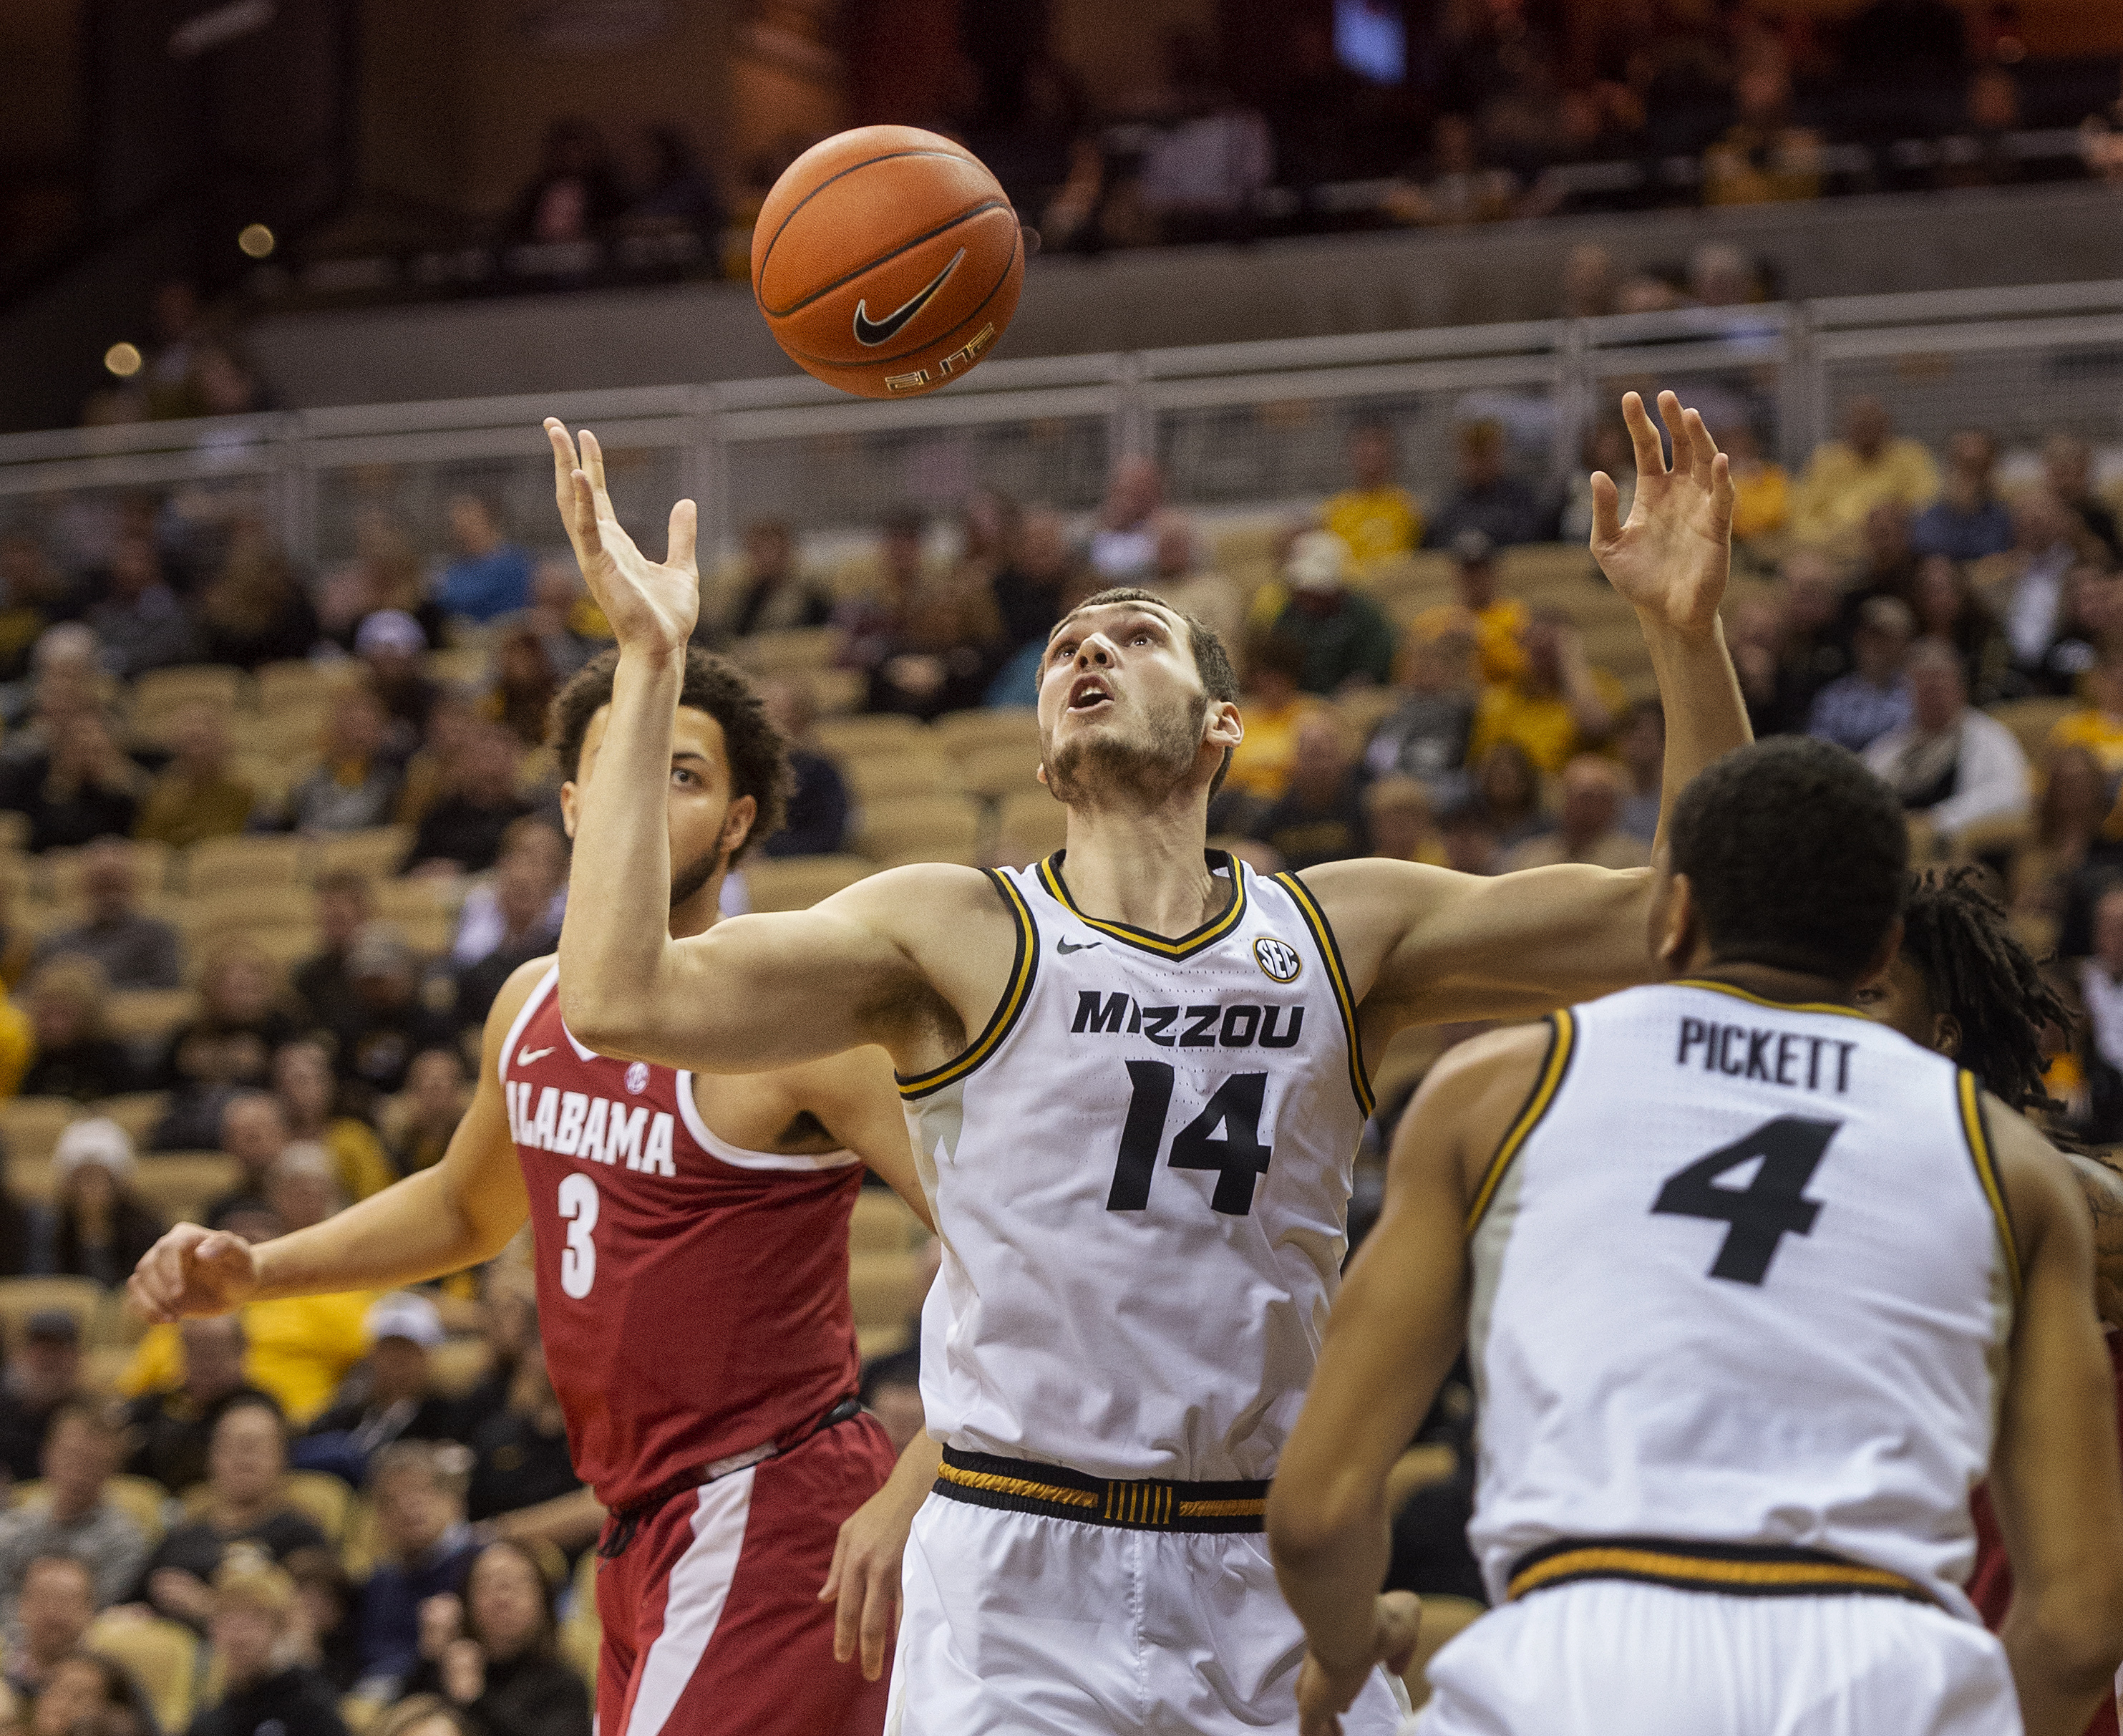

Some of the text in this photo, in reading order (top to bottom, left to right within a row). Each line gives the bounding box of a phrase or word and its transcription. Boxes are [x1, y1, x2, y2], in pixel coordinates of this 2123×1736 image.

[885, 321, 995, 392] ELITE
[1257, 939, 1298, 979] SEC
[1071, 990, 1305, 1048] MIZZOU
[1677, 1016, 1858, 1094] PICKETT
[1106, 1060, 1272, 1215] 14
[558, 1172, 600, 1300] 3
[1650, 1114, 1845, 1286] 4
